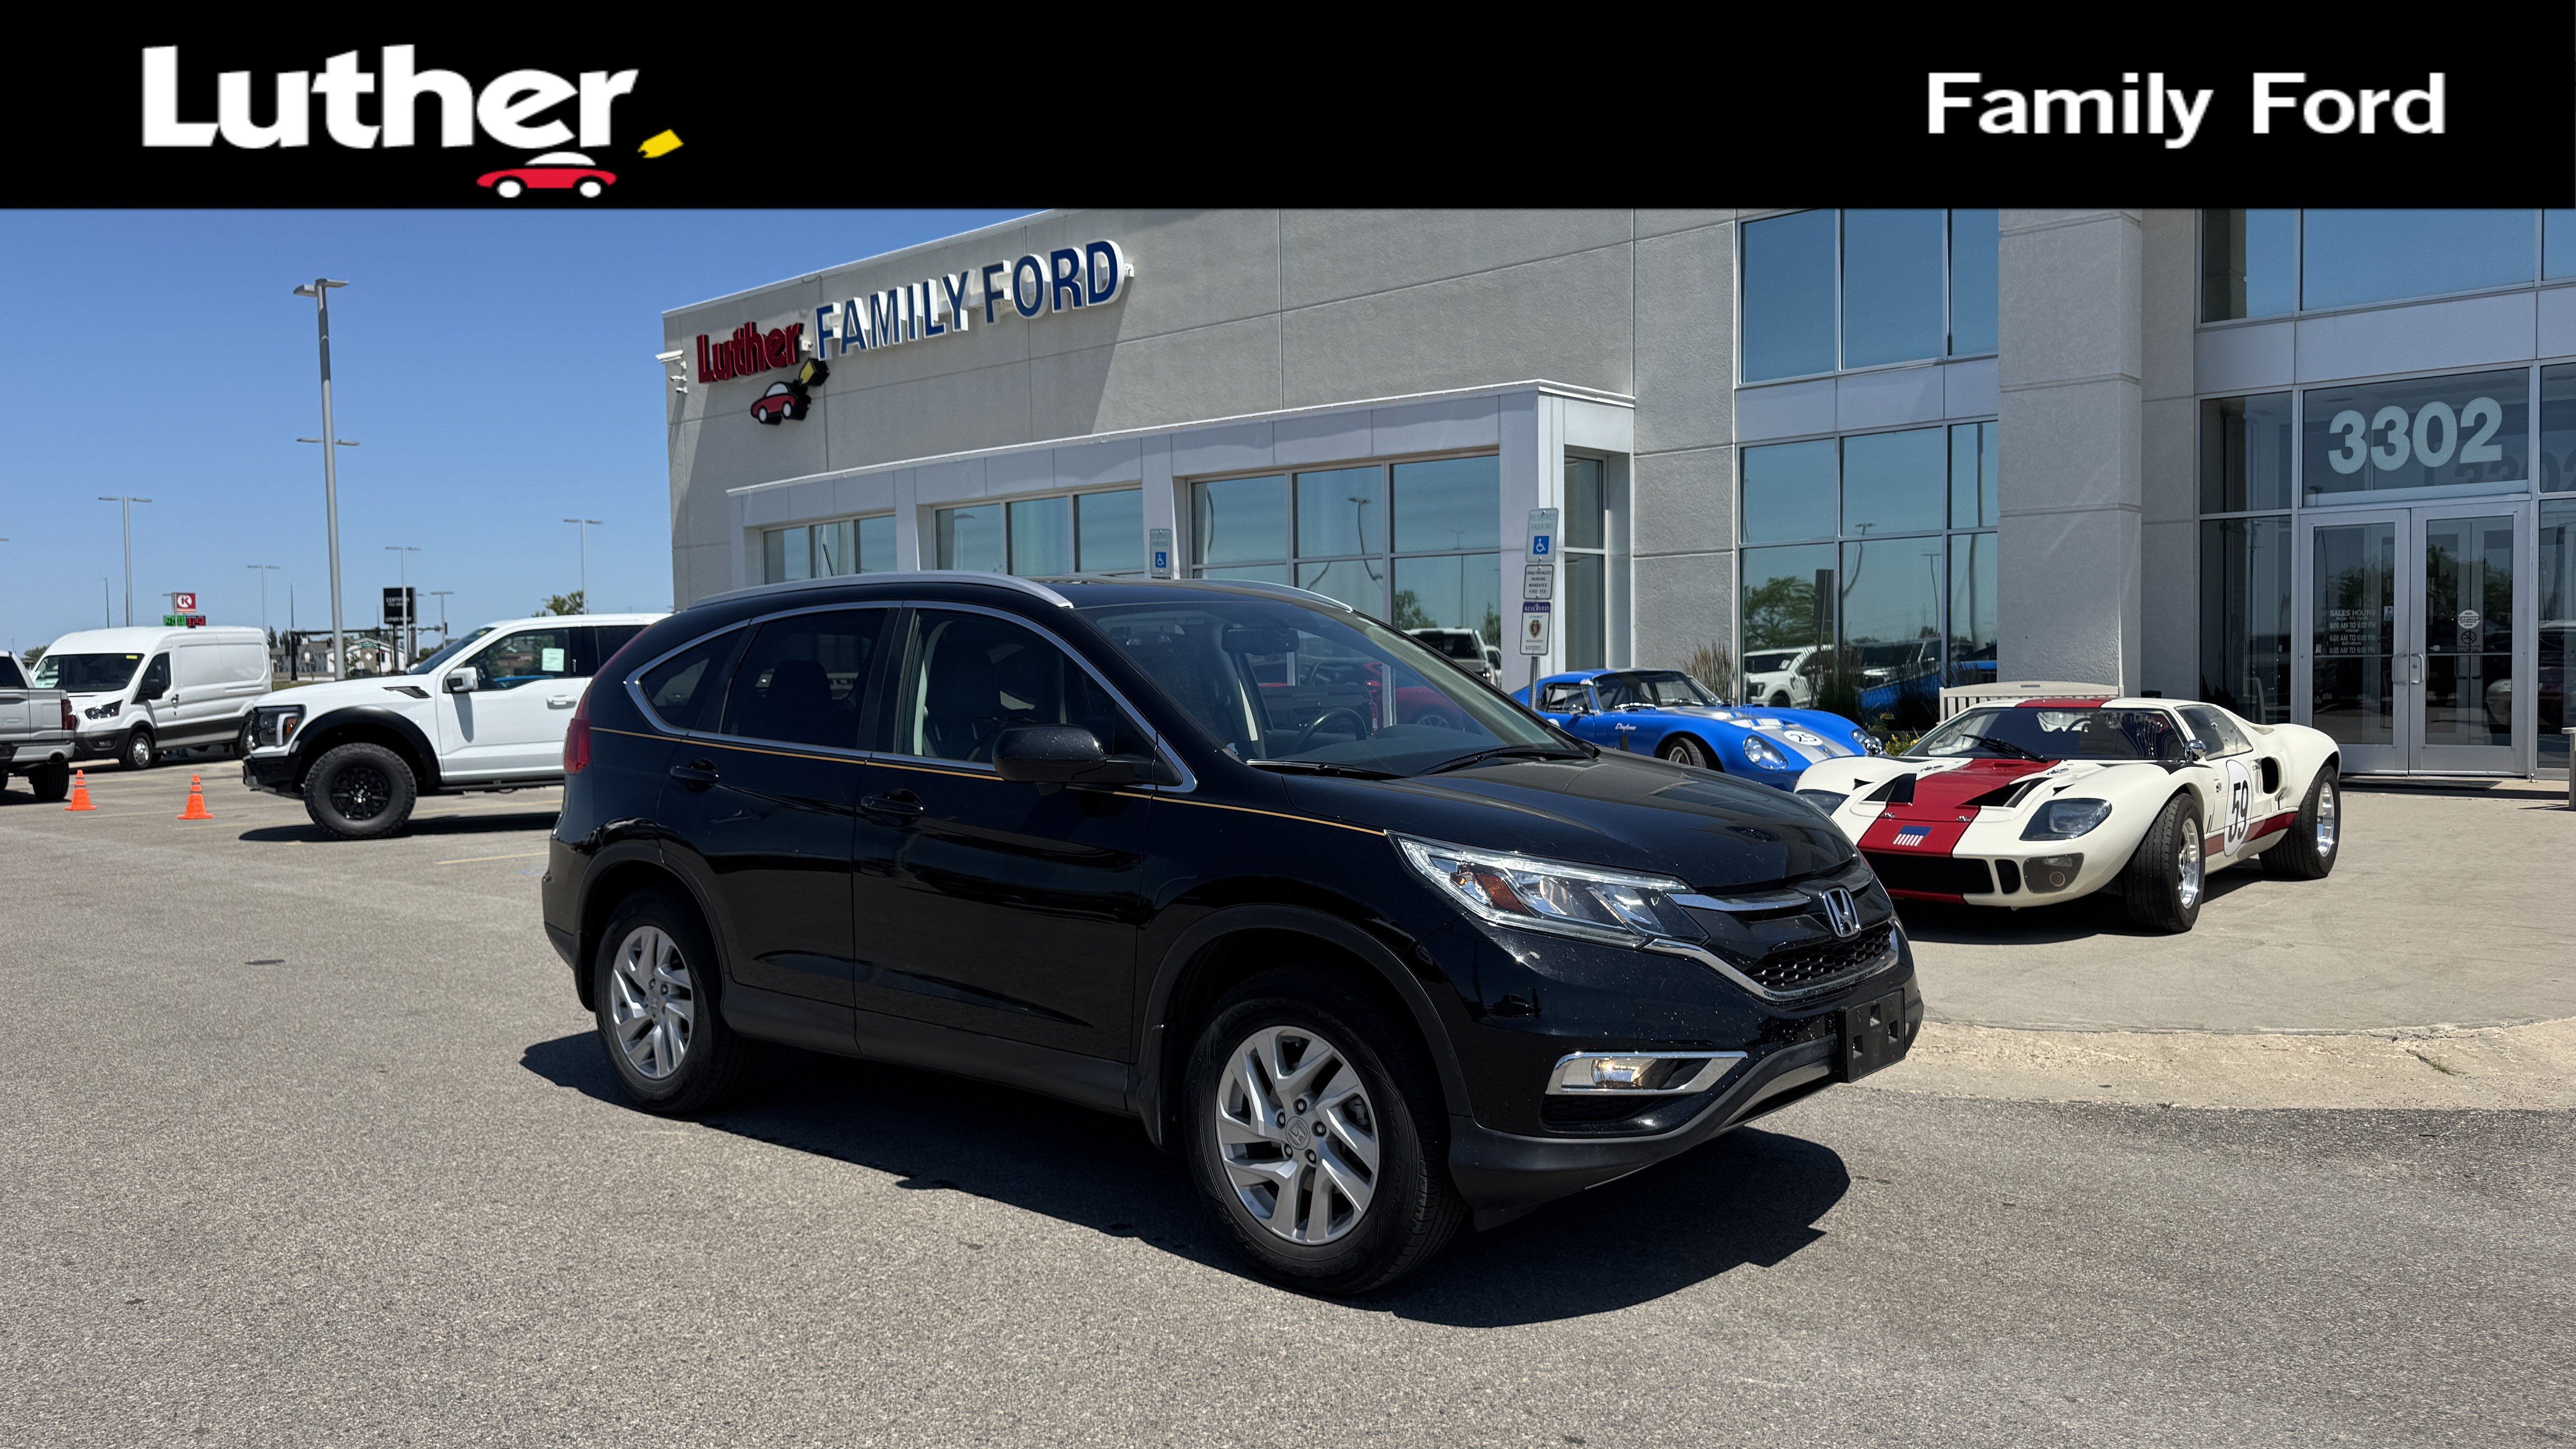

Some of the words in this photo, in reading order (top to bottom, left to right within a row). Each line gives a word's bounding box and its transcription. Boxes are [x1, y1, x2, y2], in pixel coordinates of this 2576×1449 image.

[696, 321, 805, 384] Luther
[815, 268, 975, 362] FAMILY
[981, 239, 1125, 325] FORD
[2328, 397, 2502, 474] 3302
[1789, 733, 1817, 742] 25
[2228, 780, 2249, 843] 59
